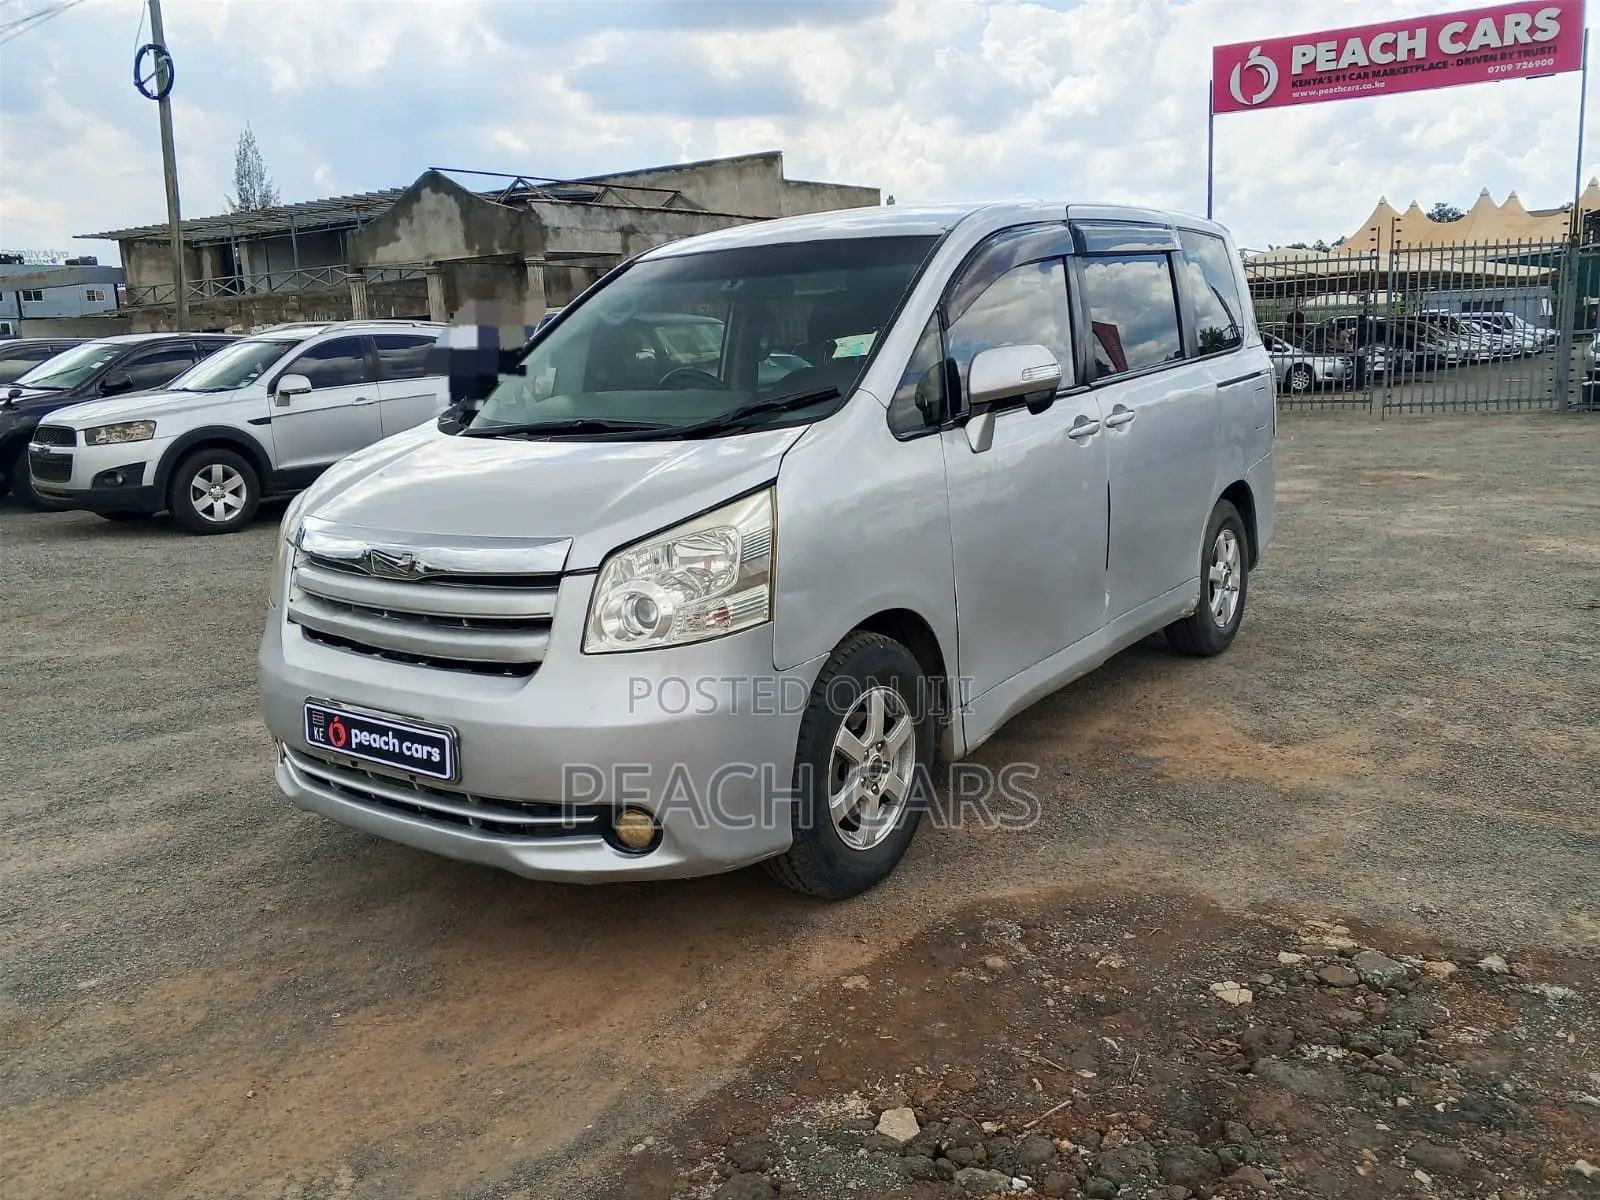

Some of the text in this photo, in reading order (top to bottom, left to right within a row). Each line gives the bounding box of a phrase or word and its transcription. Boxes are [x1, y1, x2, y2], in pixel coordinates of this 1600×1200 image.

[1292, 7, 1562, 75] PEACH CARS
[1292, 74, 1332, 88] KENYA'S
[1335, 73, 1346, 83] #1
[1349, 71, 1369, 81] CAR
[1372, 60, 1449, 78] MARKETPLACE
[1456, 54, 1498, 67] DRIVEN
[1500, 51, 1515, 61] BY
[1487, 58, 1554, 74] 0709 726900
[1292, 81, 1386, 98] www.peachcars.co.ke
[313, 725, 325, 742] KE
[351, 728, 441, 762] peach cars
